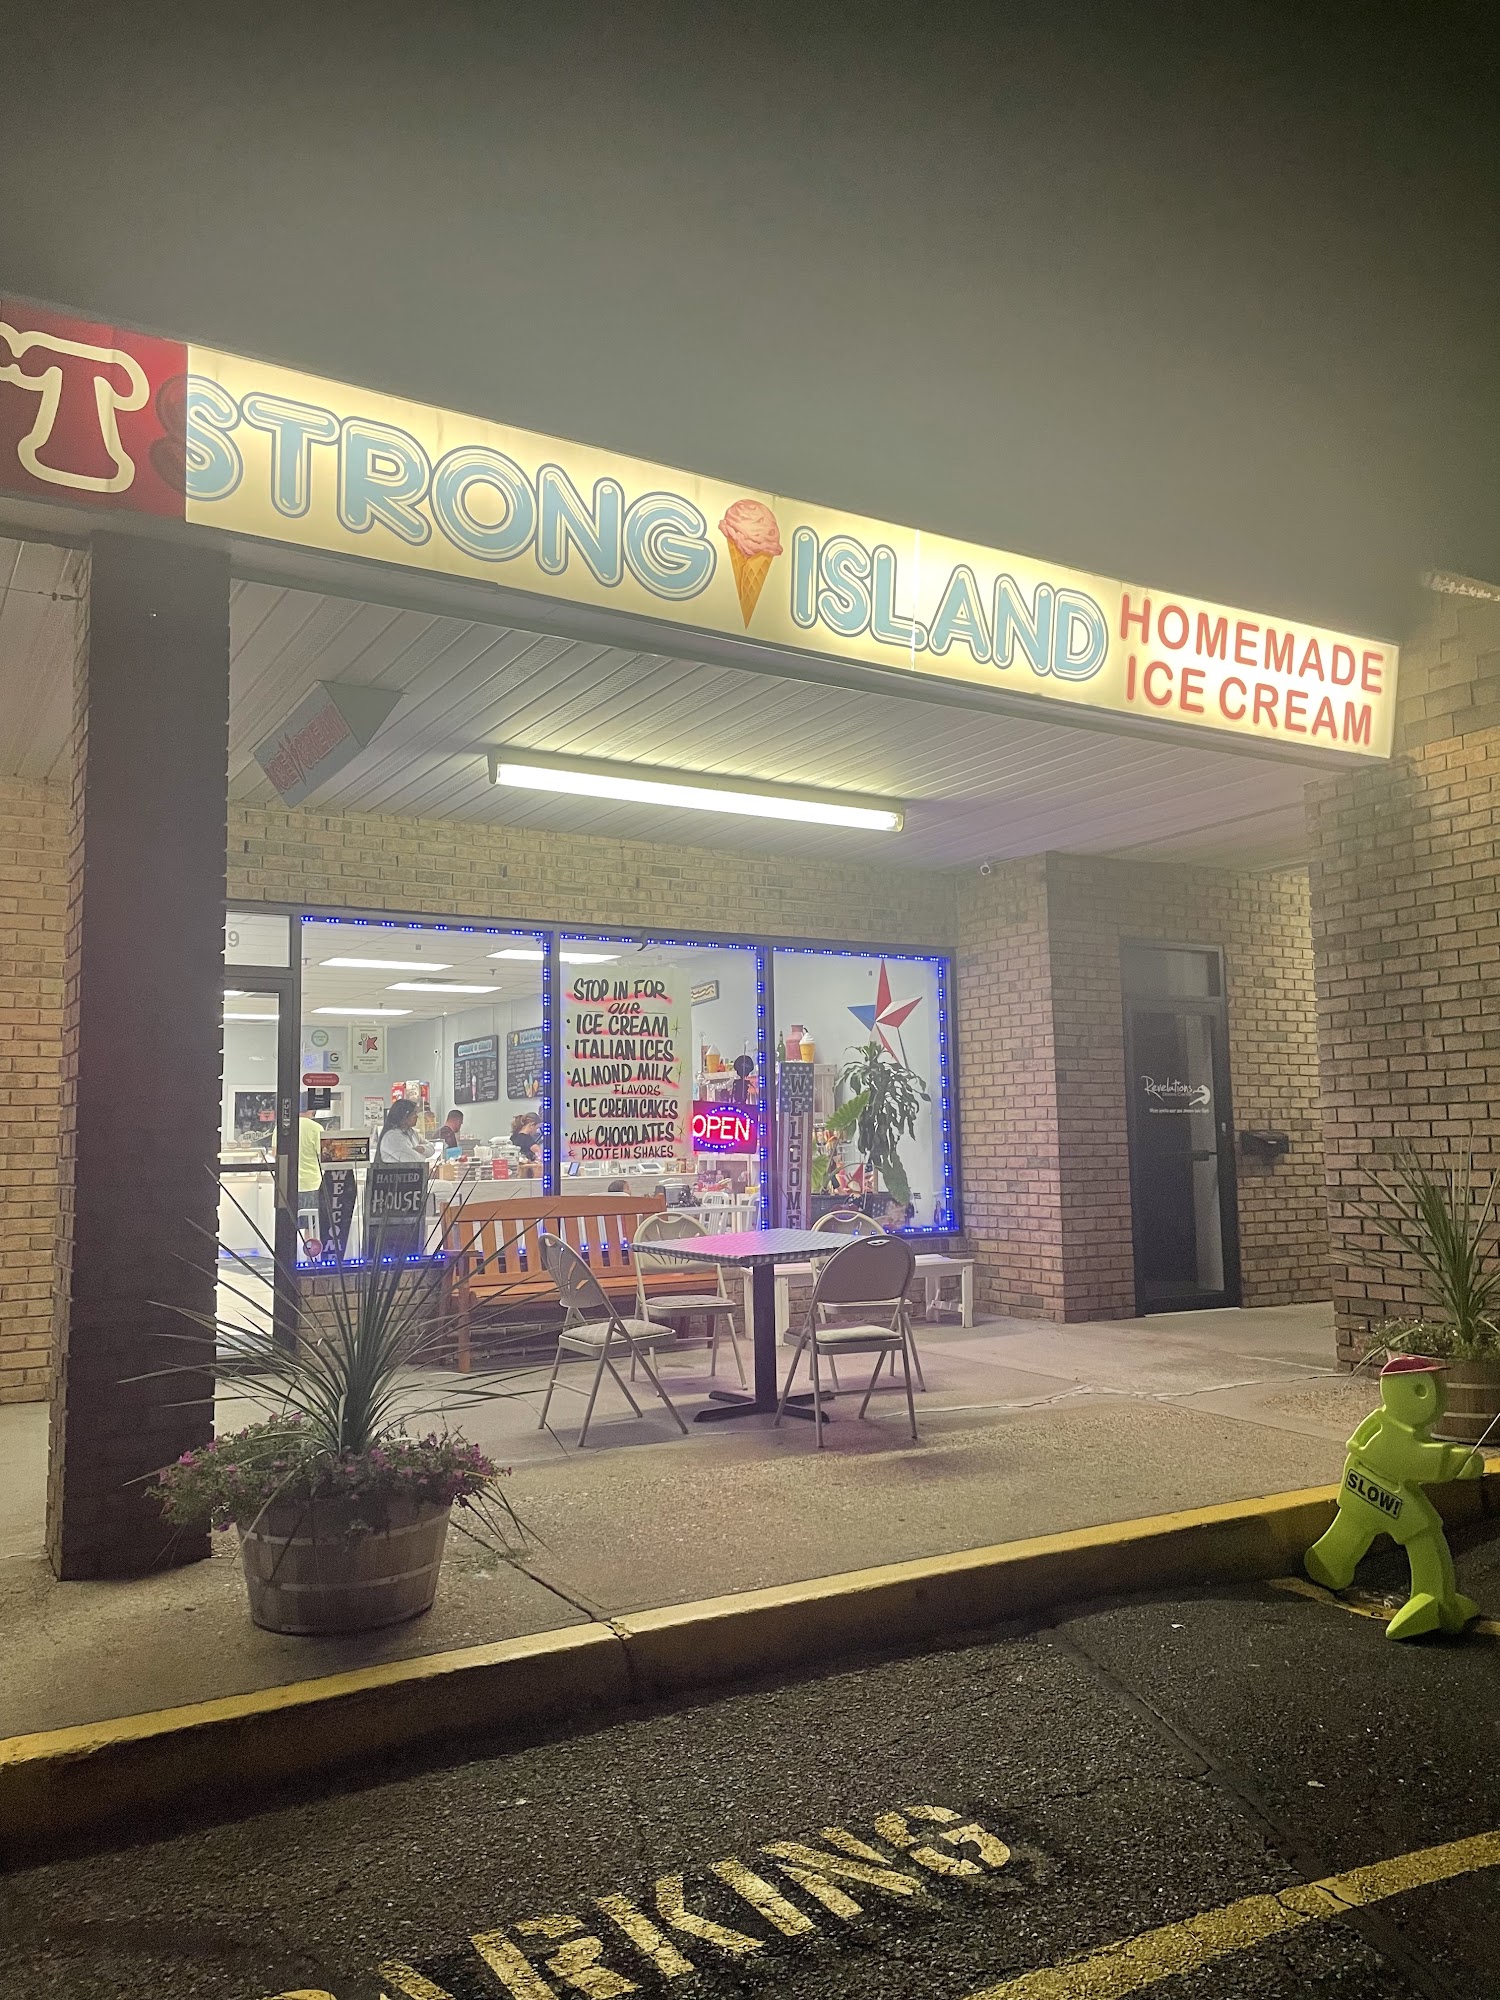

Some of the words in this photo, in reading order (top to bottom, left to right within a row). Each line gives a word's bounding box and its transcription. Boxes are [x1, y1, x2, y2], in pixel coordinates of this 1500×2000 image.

[148, 374, 717, 601] STRONG
[791, 526, 1109, 682] ISLAND
[1119, 591, 1385, 694] HOMEMADE
[1125, 655, 1206, 714] ICE
[1219, 676, 1373, 746] CREAM
[573, 978, 609, 1001] STOP
[613, 980, 628, 1000] IN
[634, 980, 668, 1000] FOR
[608, 1003, 641, 1014] OUR
[576, 1014, 603, 1035] ICE
[608, 1015, 669, 1037] CREAM
[574, 1039, 637, 1060] ITALIAN
[640, 1039, 674, 1062] ICES
[571, 1064, 632, 1087] ALMOND
[637, 1063, 674, 1084] MILK
[613, 1084, 661, 1096] FLAVORS
[1140, 1075, 1193, 1103] Revelations
[573, 1098, 597, 1118] ICE
[595, 1122, 675, 1147] CHOCOLATES
[692, 1115, 750, 1141] OPEN
[581, 1147, 631, 1160] PROTEIN
[633, 1146, 674, 1159] SHAKES
[786, 1075, 805, 1230] WELCOME
[376, 1172, 420, 1184] HAUNTED
[372, 1189, 422, 1214] HOUSE
[1348, 1473, 1401, 1515] SLOW!
[262, 1804, 1013, 2000] RKING
